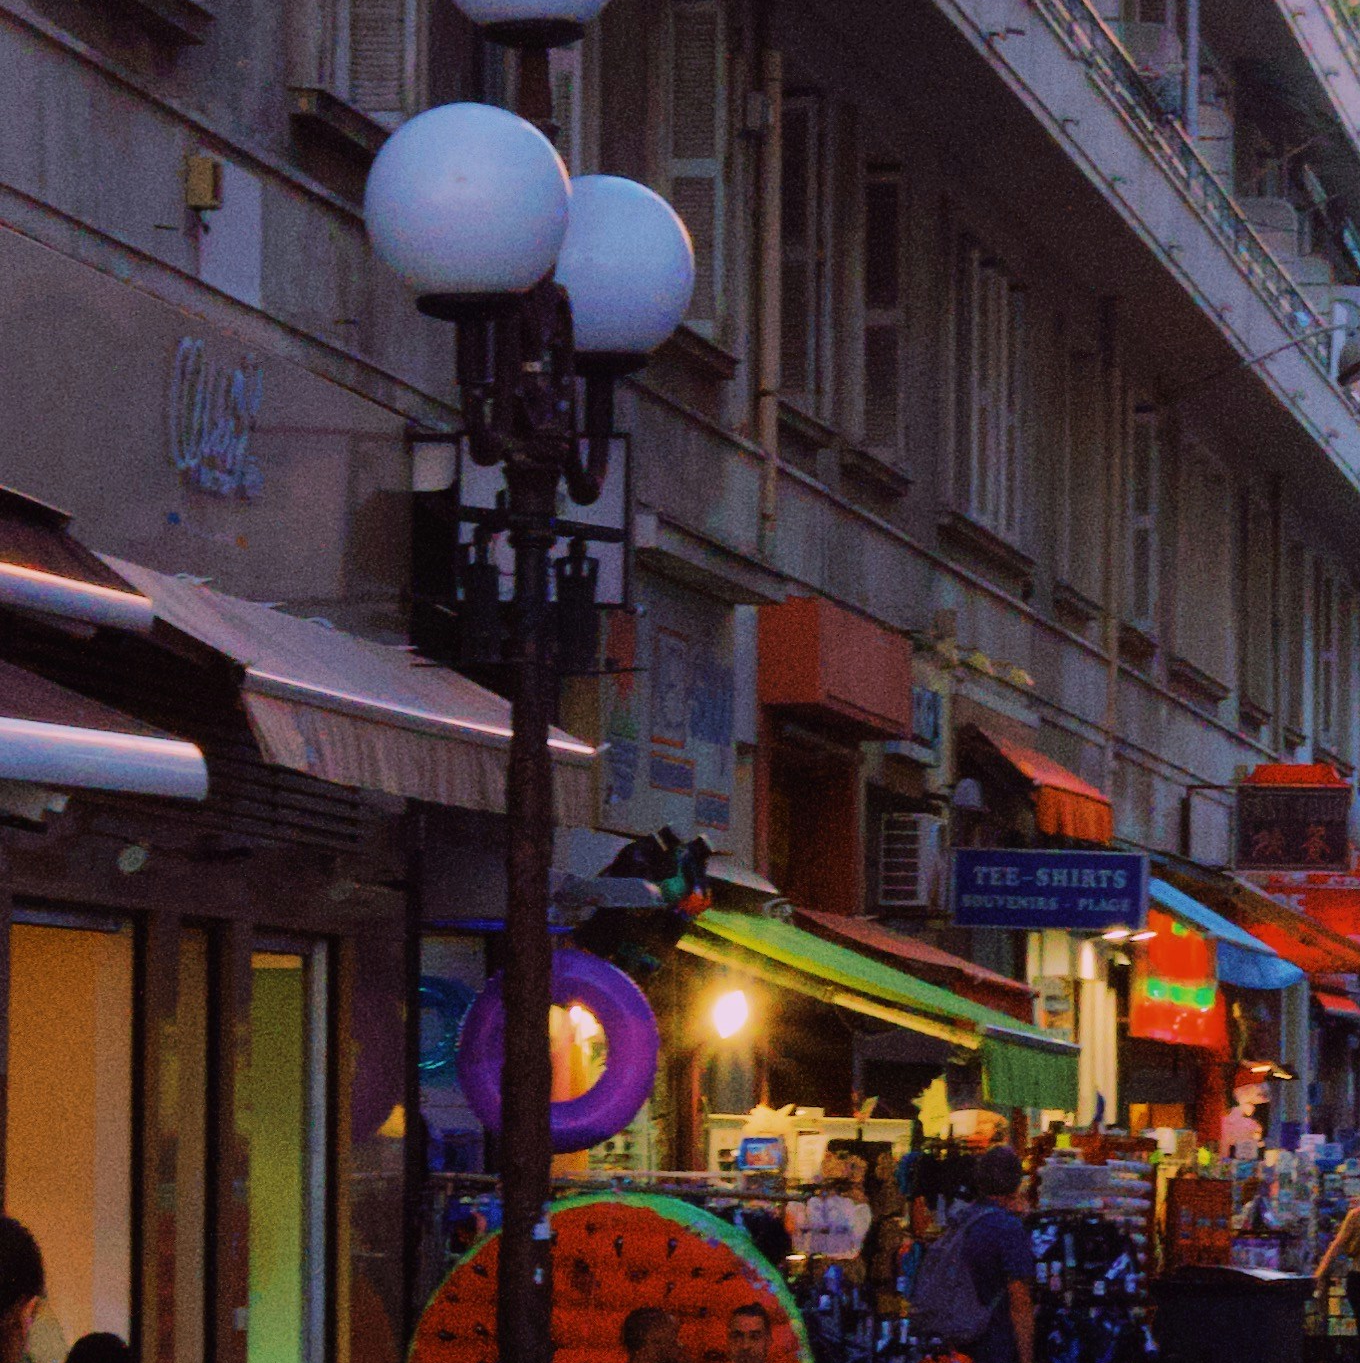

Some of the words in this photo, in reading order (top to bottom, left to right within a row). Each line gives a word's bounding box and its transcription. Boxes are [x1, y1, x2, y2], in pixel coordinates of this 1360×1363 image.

[973, 865, 1128, 888] TEE-SHIRTS
[961, 894, 1060, 911] SOUVENIRS
[1078, 897, 1132, 911] PLAGE
